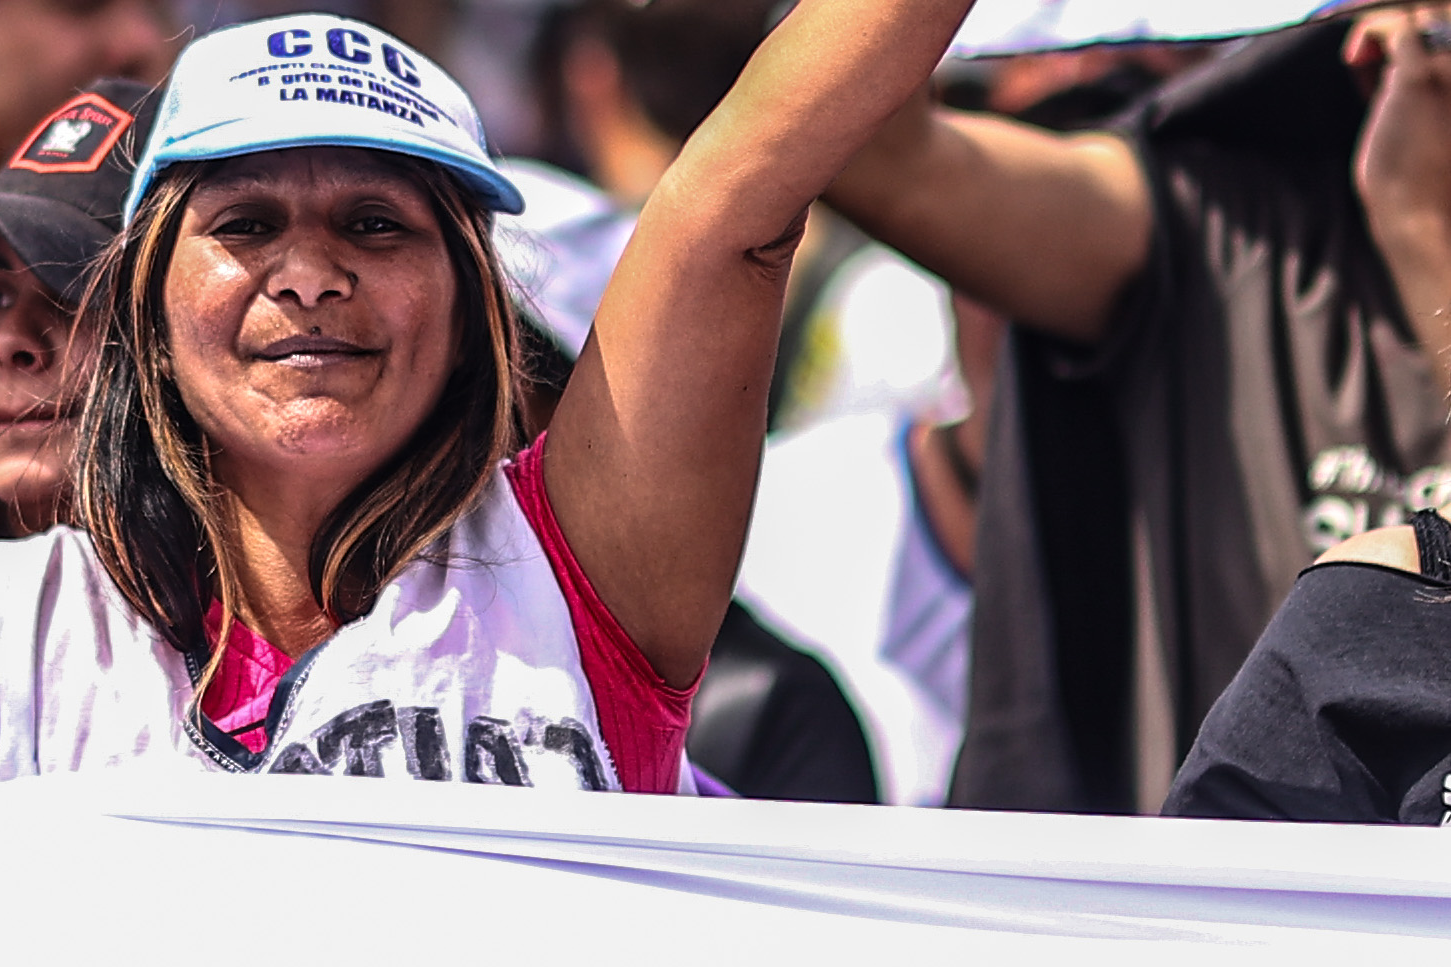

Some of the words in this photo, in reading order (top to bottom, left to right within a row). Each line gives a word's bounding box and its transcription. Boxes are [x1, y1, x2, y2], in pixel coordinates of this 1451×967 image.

[267, 28, 421, 88] CCC
[338, 75, 363, 88] de
[280, 88, 308, 101] LA
[316, 87, 426, 128] MATANZA
